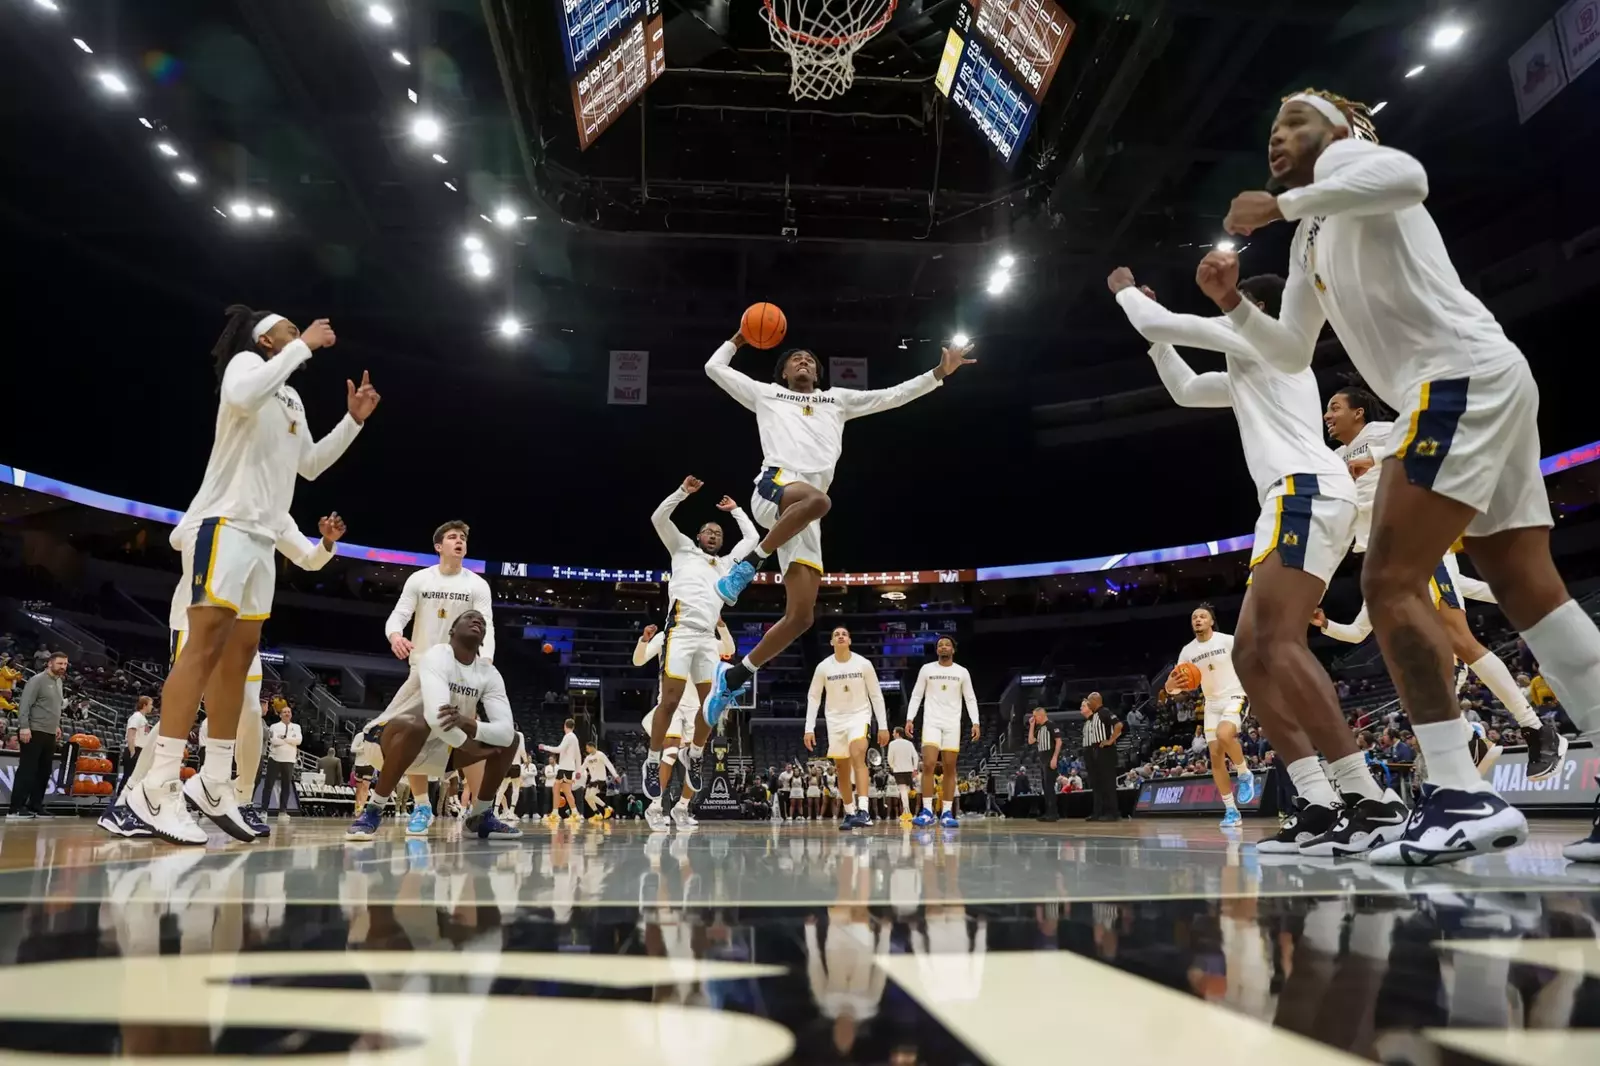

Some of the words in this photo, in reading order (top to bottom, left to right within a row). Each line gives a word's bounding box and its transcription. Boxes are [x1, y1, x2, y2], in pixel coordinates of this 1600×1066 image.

[594, 2, 604, 14] 0
[620, 7, 629, 18] 0
[582, 13, 592, 24] 0
[956, 3, 968, 28] 1:35
[976, 8, 990, 34] PLY
[988, 23, 998, 38] 5
[998, 1, 1007, 13] 0
[609, 18, 618, 29] 0
[1030, 36, 1040, 49] 0
[1040, 9, 1050, 23] 0
[598, 28, 608, 40] 0
[633, 20, 644, 43] PLY
[652, 28, 663, 41] 0
[998, 33, 1010, 50] 13
[1008, 11, 1018, 25] 0
[570, 24, 580, 36] 0
[575, 50, 584, 62] 0
[586, 39, 596, 50] 0
[1008, 46, 1020, 65] 14
[1019, 24, 1028, 37] 0
[1029, 70, 1042, 89] 35
[1041, 48, 1050, 61] 0
[1052, 22, 1062, 36] 0
[626, 62, 634, 72] 0
[952, 83, 964, 104] PLY
[960, 62, 972, 84] PTS
[967, 40, 980, 62] FLS
[615, 72, 624, 82] 0
[981, 90, 990, 100] 0
[988, 67, 998, 79] 0
[605, 82, 614, 92] 0
[628, 84, 636, 94] 0
[964, 99, 973, 112] 2
[971, 78, 980, 90] 0
[978, 56, 988, 68] 0
[594, 92, 603, 103] 0
[618, 92, 626, 104] 0
[990, 100, 998, 112] 0
[998, 78, 1007, 90] 0
[608, 103, 616, 114] 0
[1000, 112, 1008, 124] 0
[1008, 89, 1017, 101] 0
[598, 113, 606, 124] 0
[1010, 124, 1018, 135] 0
[1018, 102, 1028, 114] 0
[587, 124, 596, 134] 0
[422, 591, 449, 600] MURRAY
[450, 592, 470, 602] STATE
[1192, 652, 1210, 664] MURRAY
[1210, 648, 1226, 657] STATE
[827, 672, 848, 681] MURRAY
[1154, 786, 1184, 805] MARCH?
